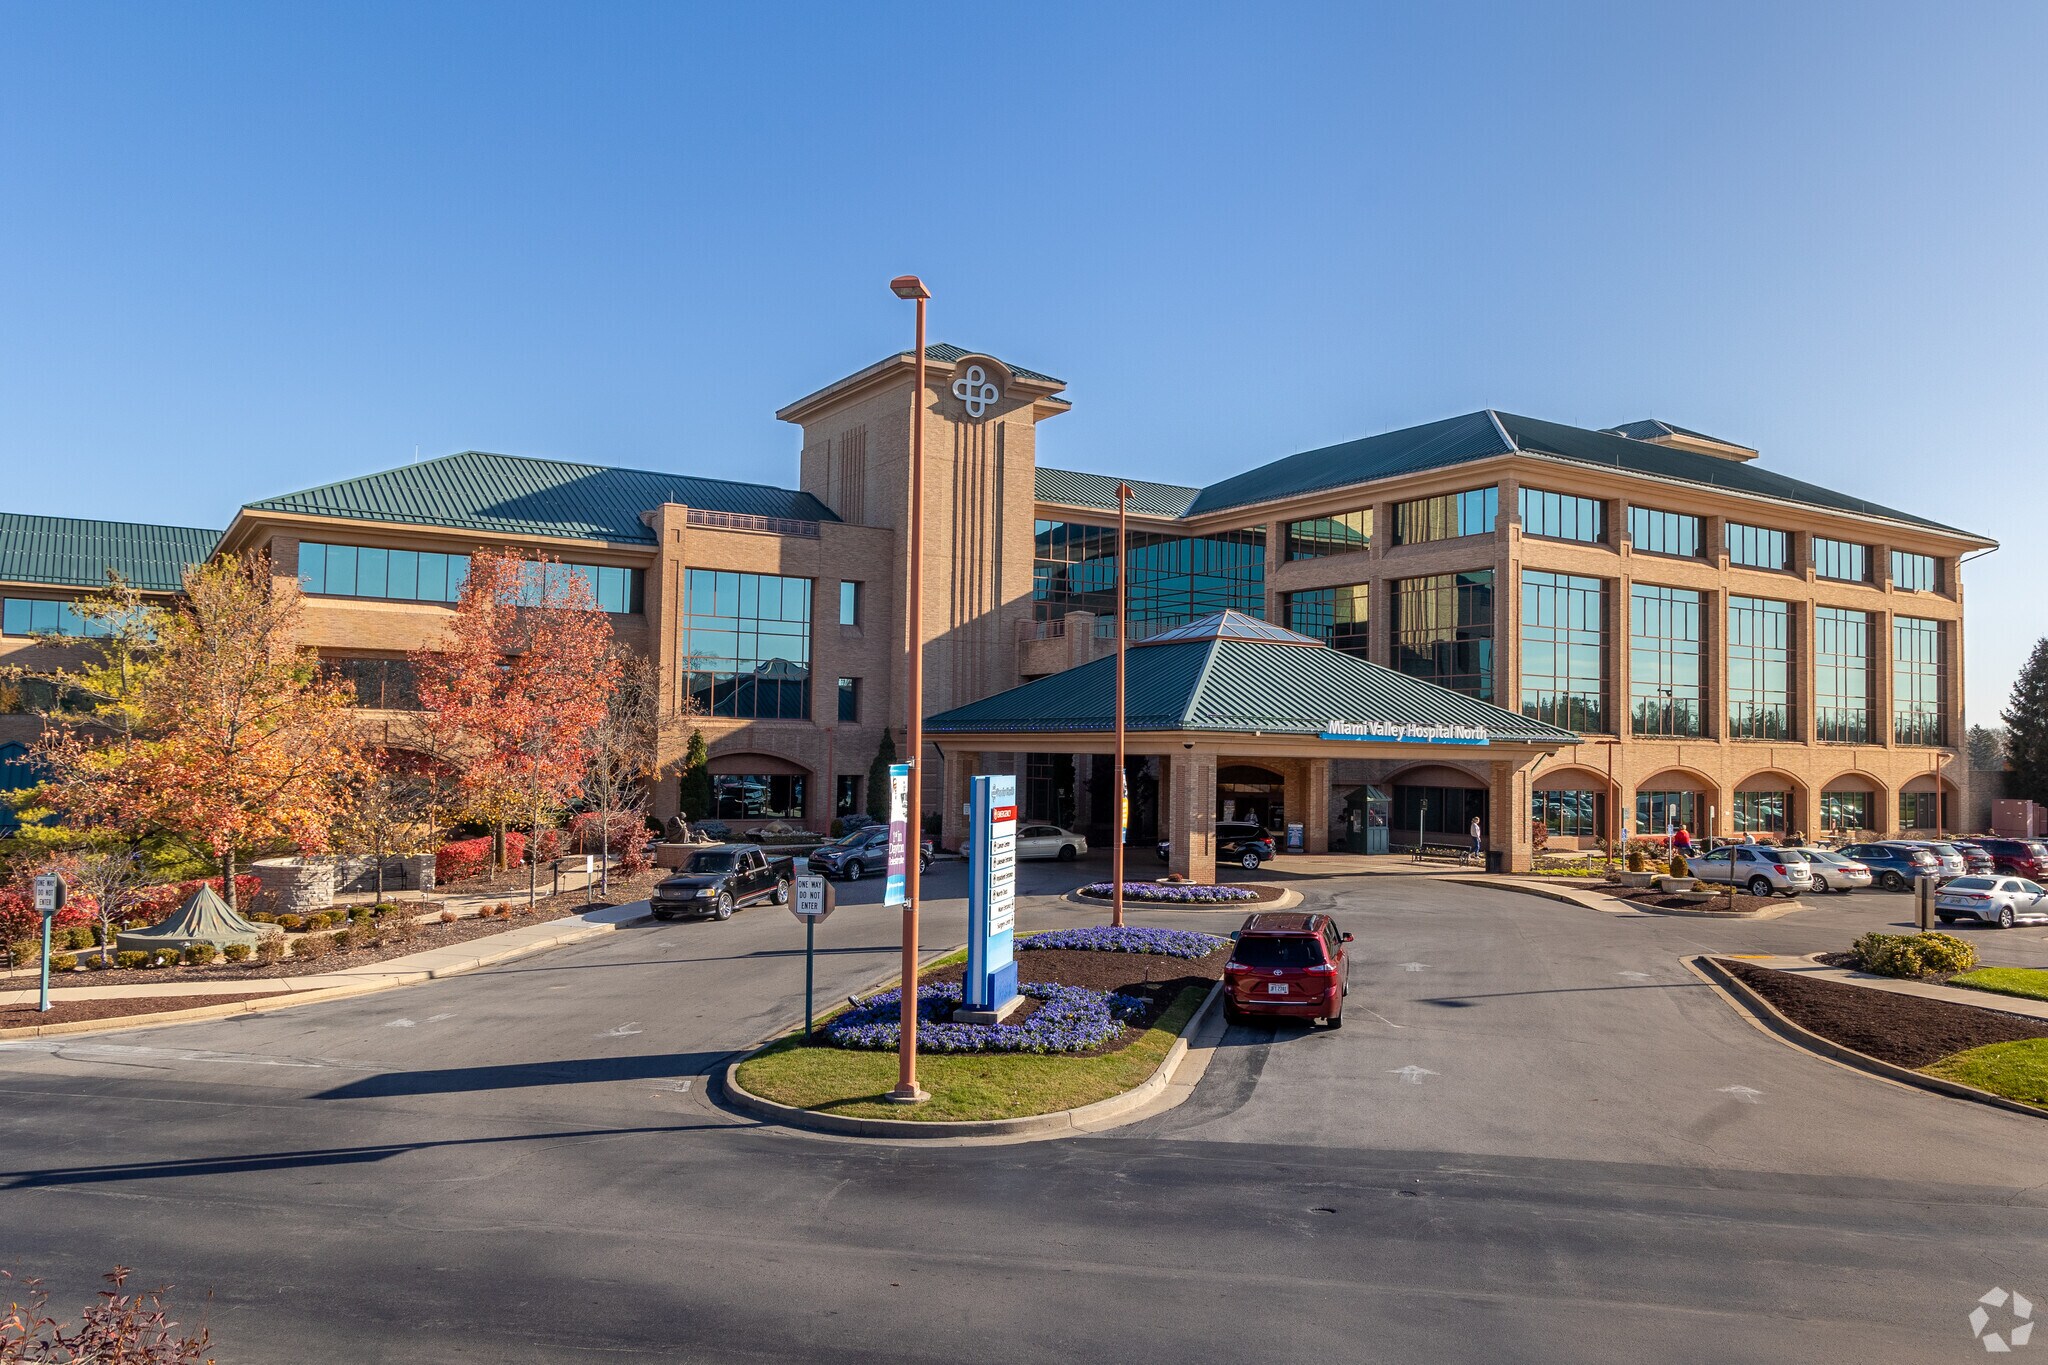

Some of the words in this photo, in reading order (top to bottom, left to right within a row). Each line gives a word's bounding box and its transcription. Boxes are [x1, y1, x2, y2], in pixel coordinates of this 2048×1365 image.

[1328, 720, 1367, 735] Miami
[1368, 721, 1404, 741] Valley
[1407, 723, 1453, 742] Hospital
[1455, 725, 1487, 739] North
[800, 891, 807, 899] DO
